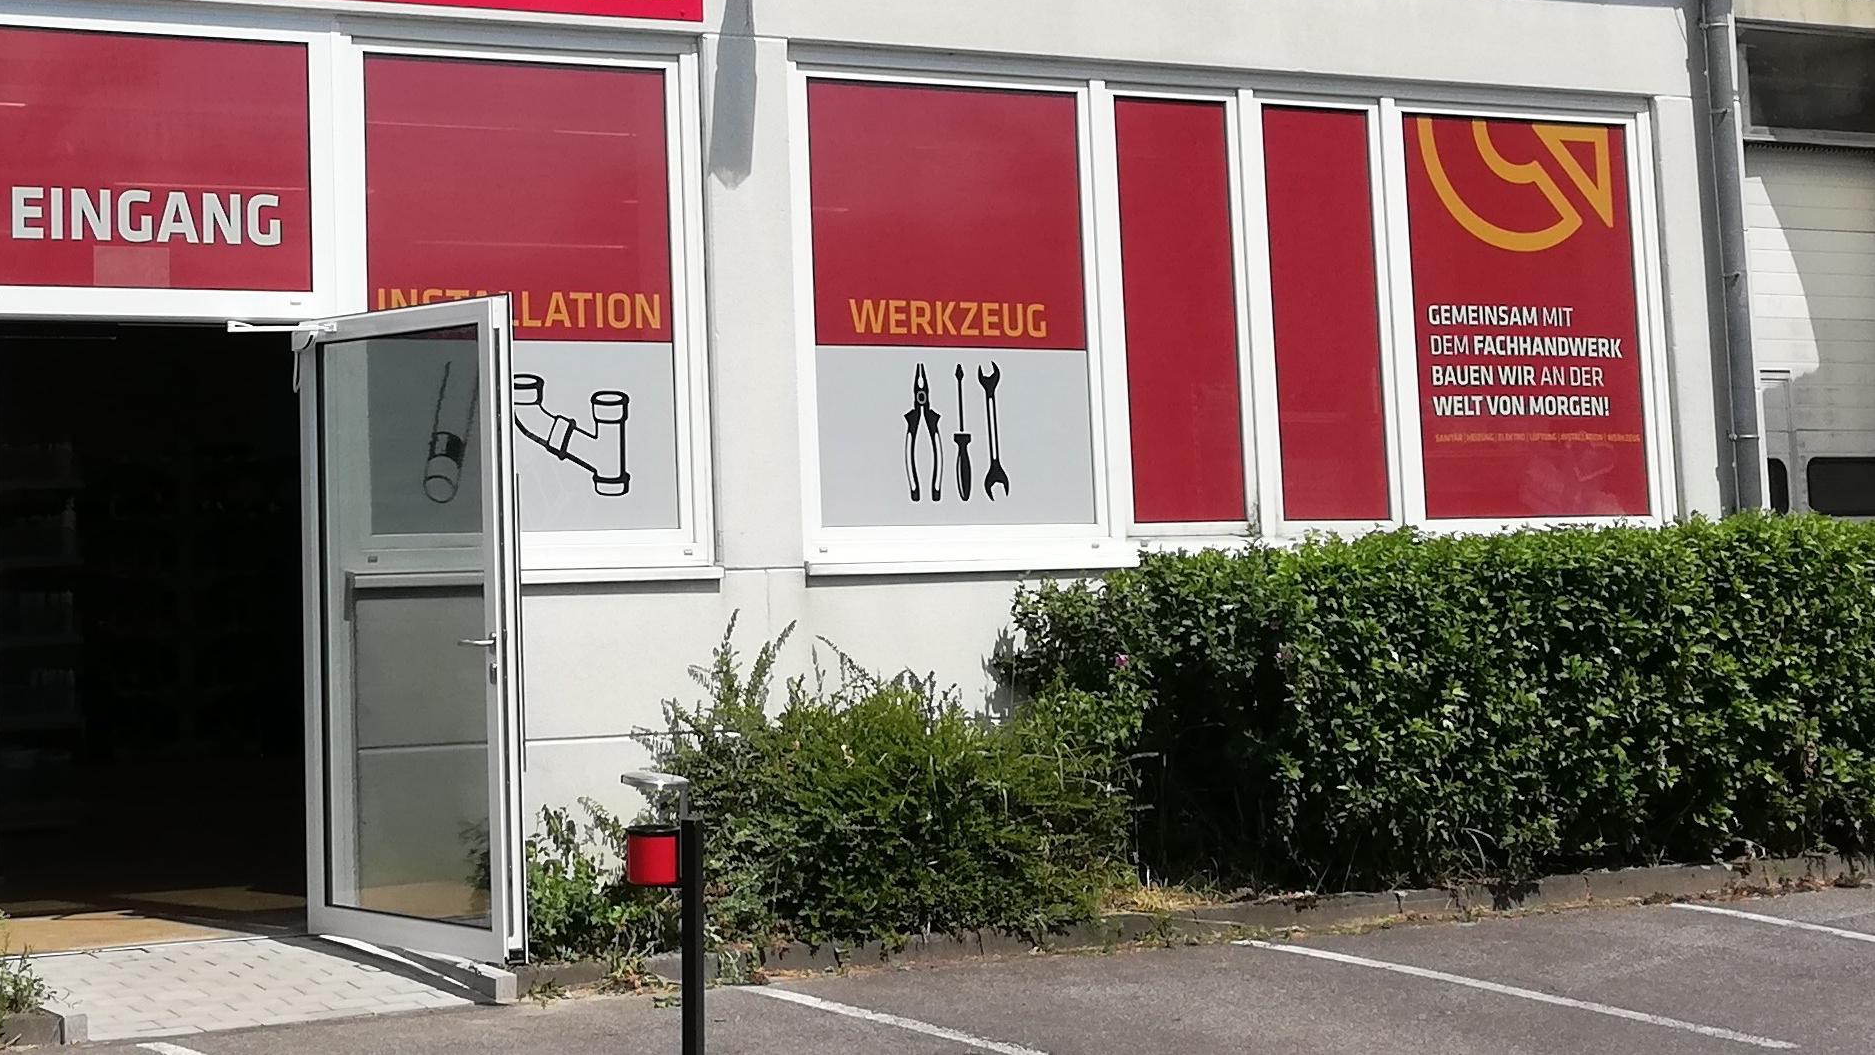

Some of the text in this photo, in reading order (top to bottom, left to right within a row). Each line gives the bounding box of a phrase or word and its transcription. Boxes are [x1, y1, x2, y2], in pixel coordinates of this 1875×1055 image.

[10, 186, 282, 246] EINGANG
[849, 298, 1048, 338] WERKZEUG
[1428, 305, 1573, 327] GEMEINSAM MIT
[1430, 335, 1622, 358] DEM FACHHANDWERK
[1432, 366, 1604, 386] BAUEN WIR AN DER
[1433, 396, 1610, 416] WELT VON MORGEN!
